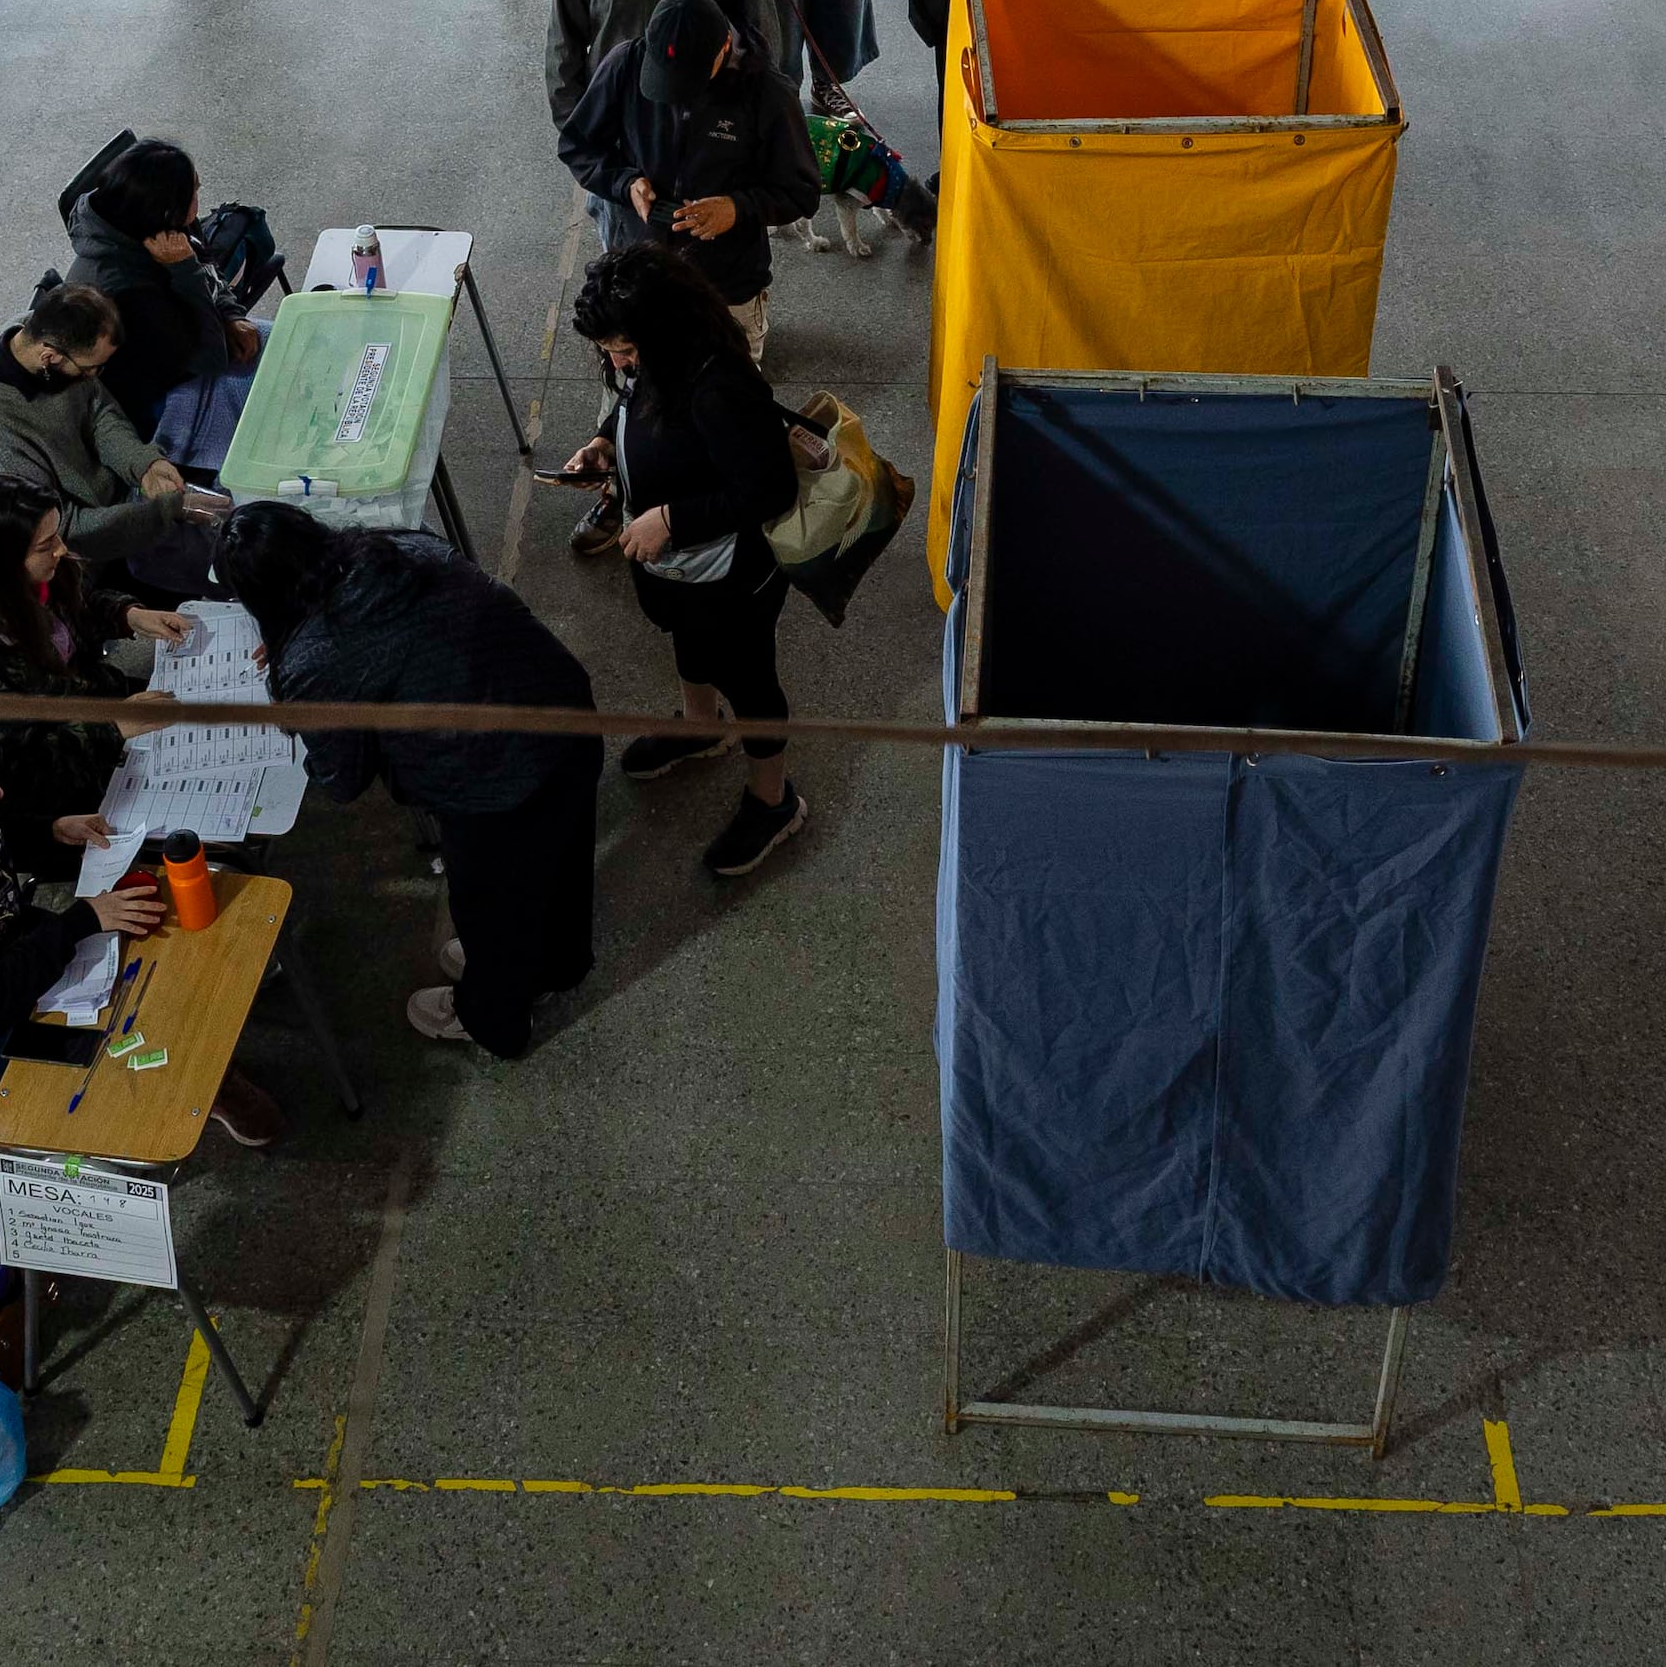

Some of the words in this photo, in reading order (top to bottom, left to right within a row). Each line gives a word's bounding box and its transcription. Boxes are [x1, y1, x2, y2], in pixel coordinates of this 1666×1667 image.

[358, 348, 377, 386] PRESIDENTE
[365, 363, 381, 392] SEGUNDA
[15, 1162, 60, 1176] SEGUNDA
[9, 1179, 82, 1206] MESA:
[128, 1183, 155, 1198] 2025
[53, 1205, 114, 1223] VOCALES
[9, 1218, 16, 1226] 2
[11, 1228, 18, 1236] 3
[11, 1239, 18, 1247] 4
[13, 1250, 20, 1259] 5
